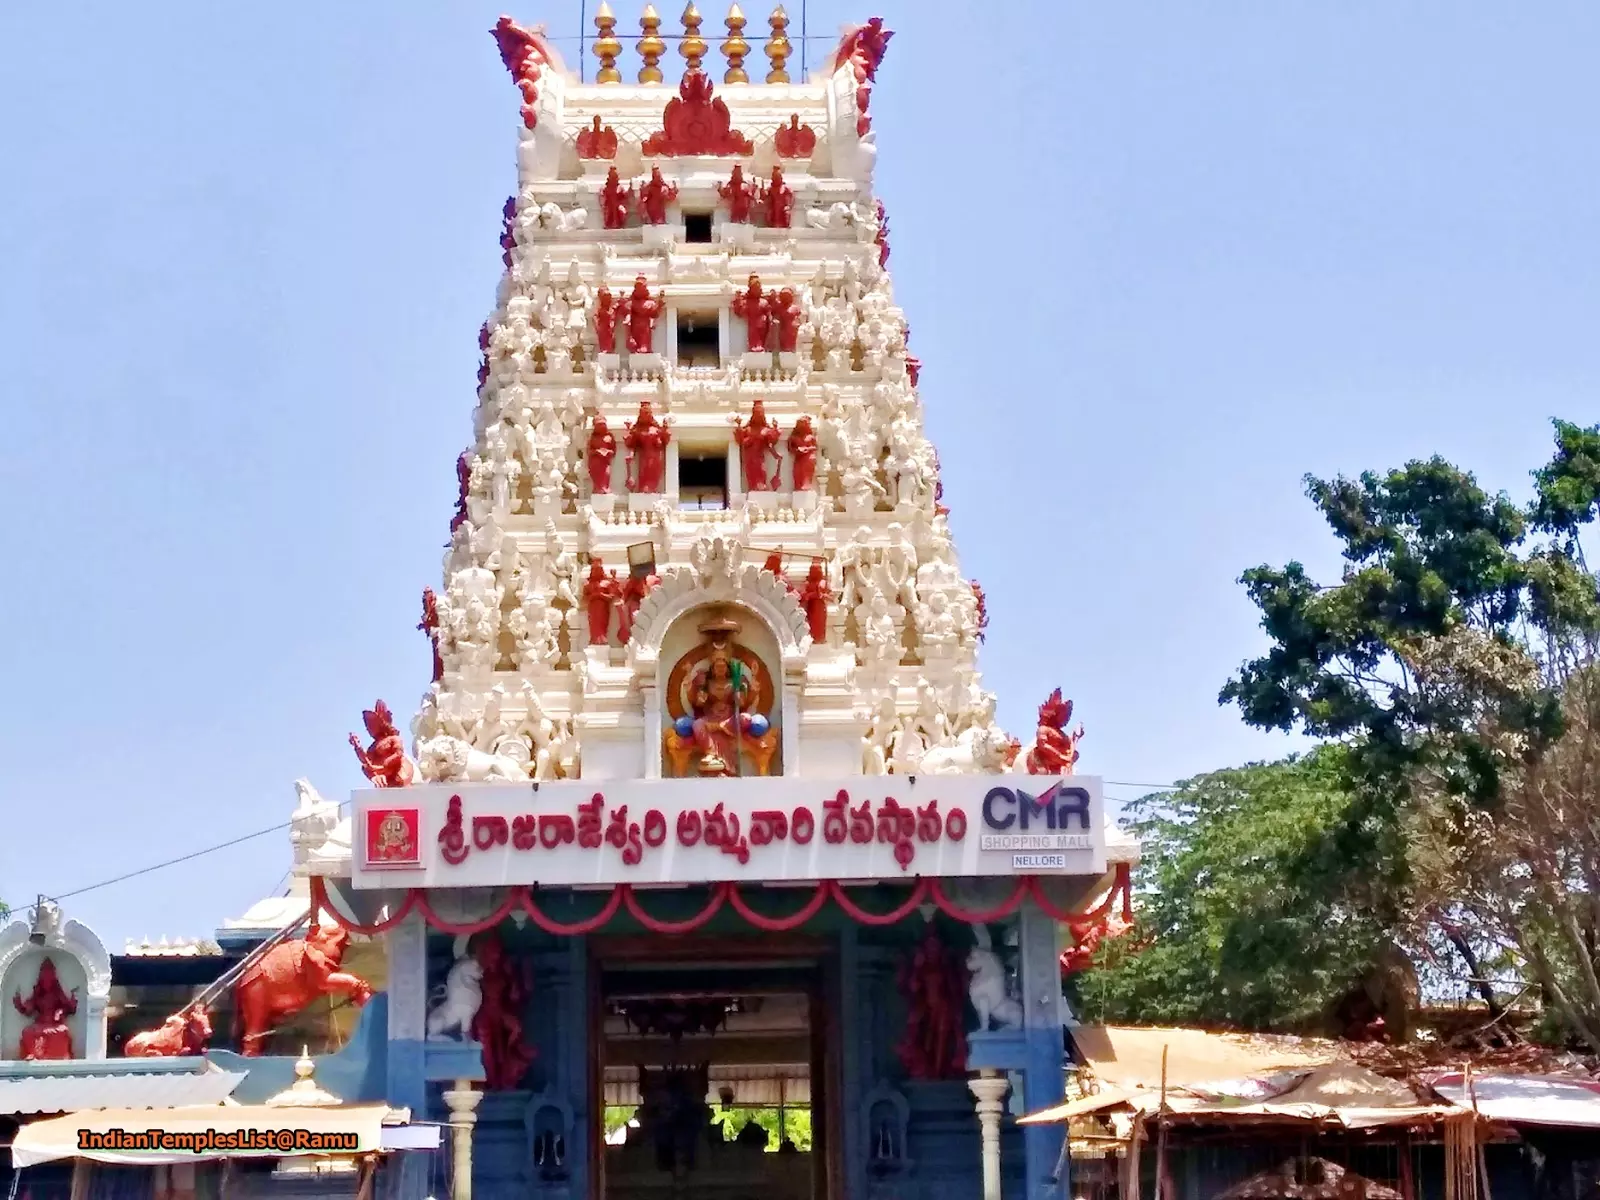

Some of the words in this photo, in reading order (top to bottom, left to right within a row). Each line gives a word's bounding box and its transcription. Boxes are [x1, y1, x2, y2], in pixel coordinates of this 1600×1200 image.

[982, 780, 1091, 830] CMR
[984, 836, 1051, 849] SHOPPING
[1057, 836, 1093, 848] MALL
[1015, 856, 1063, 866] NELLORE
